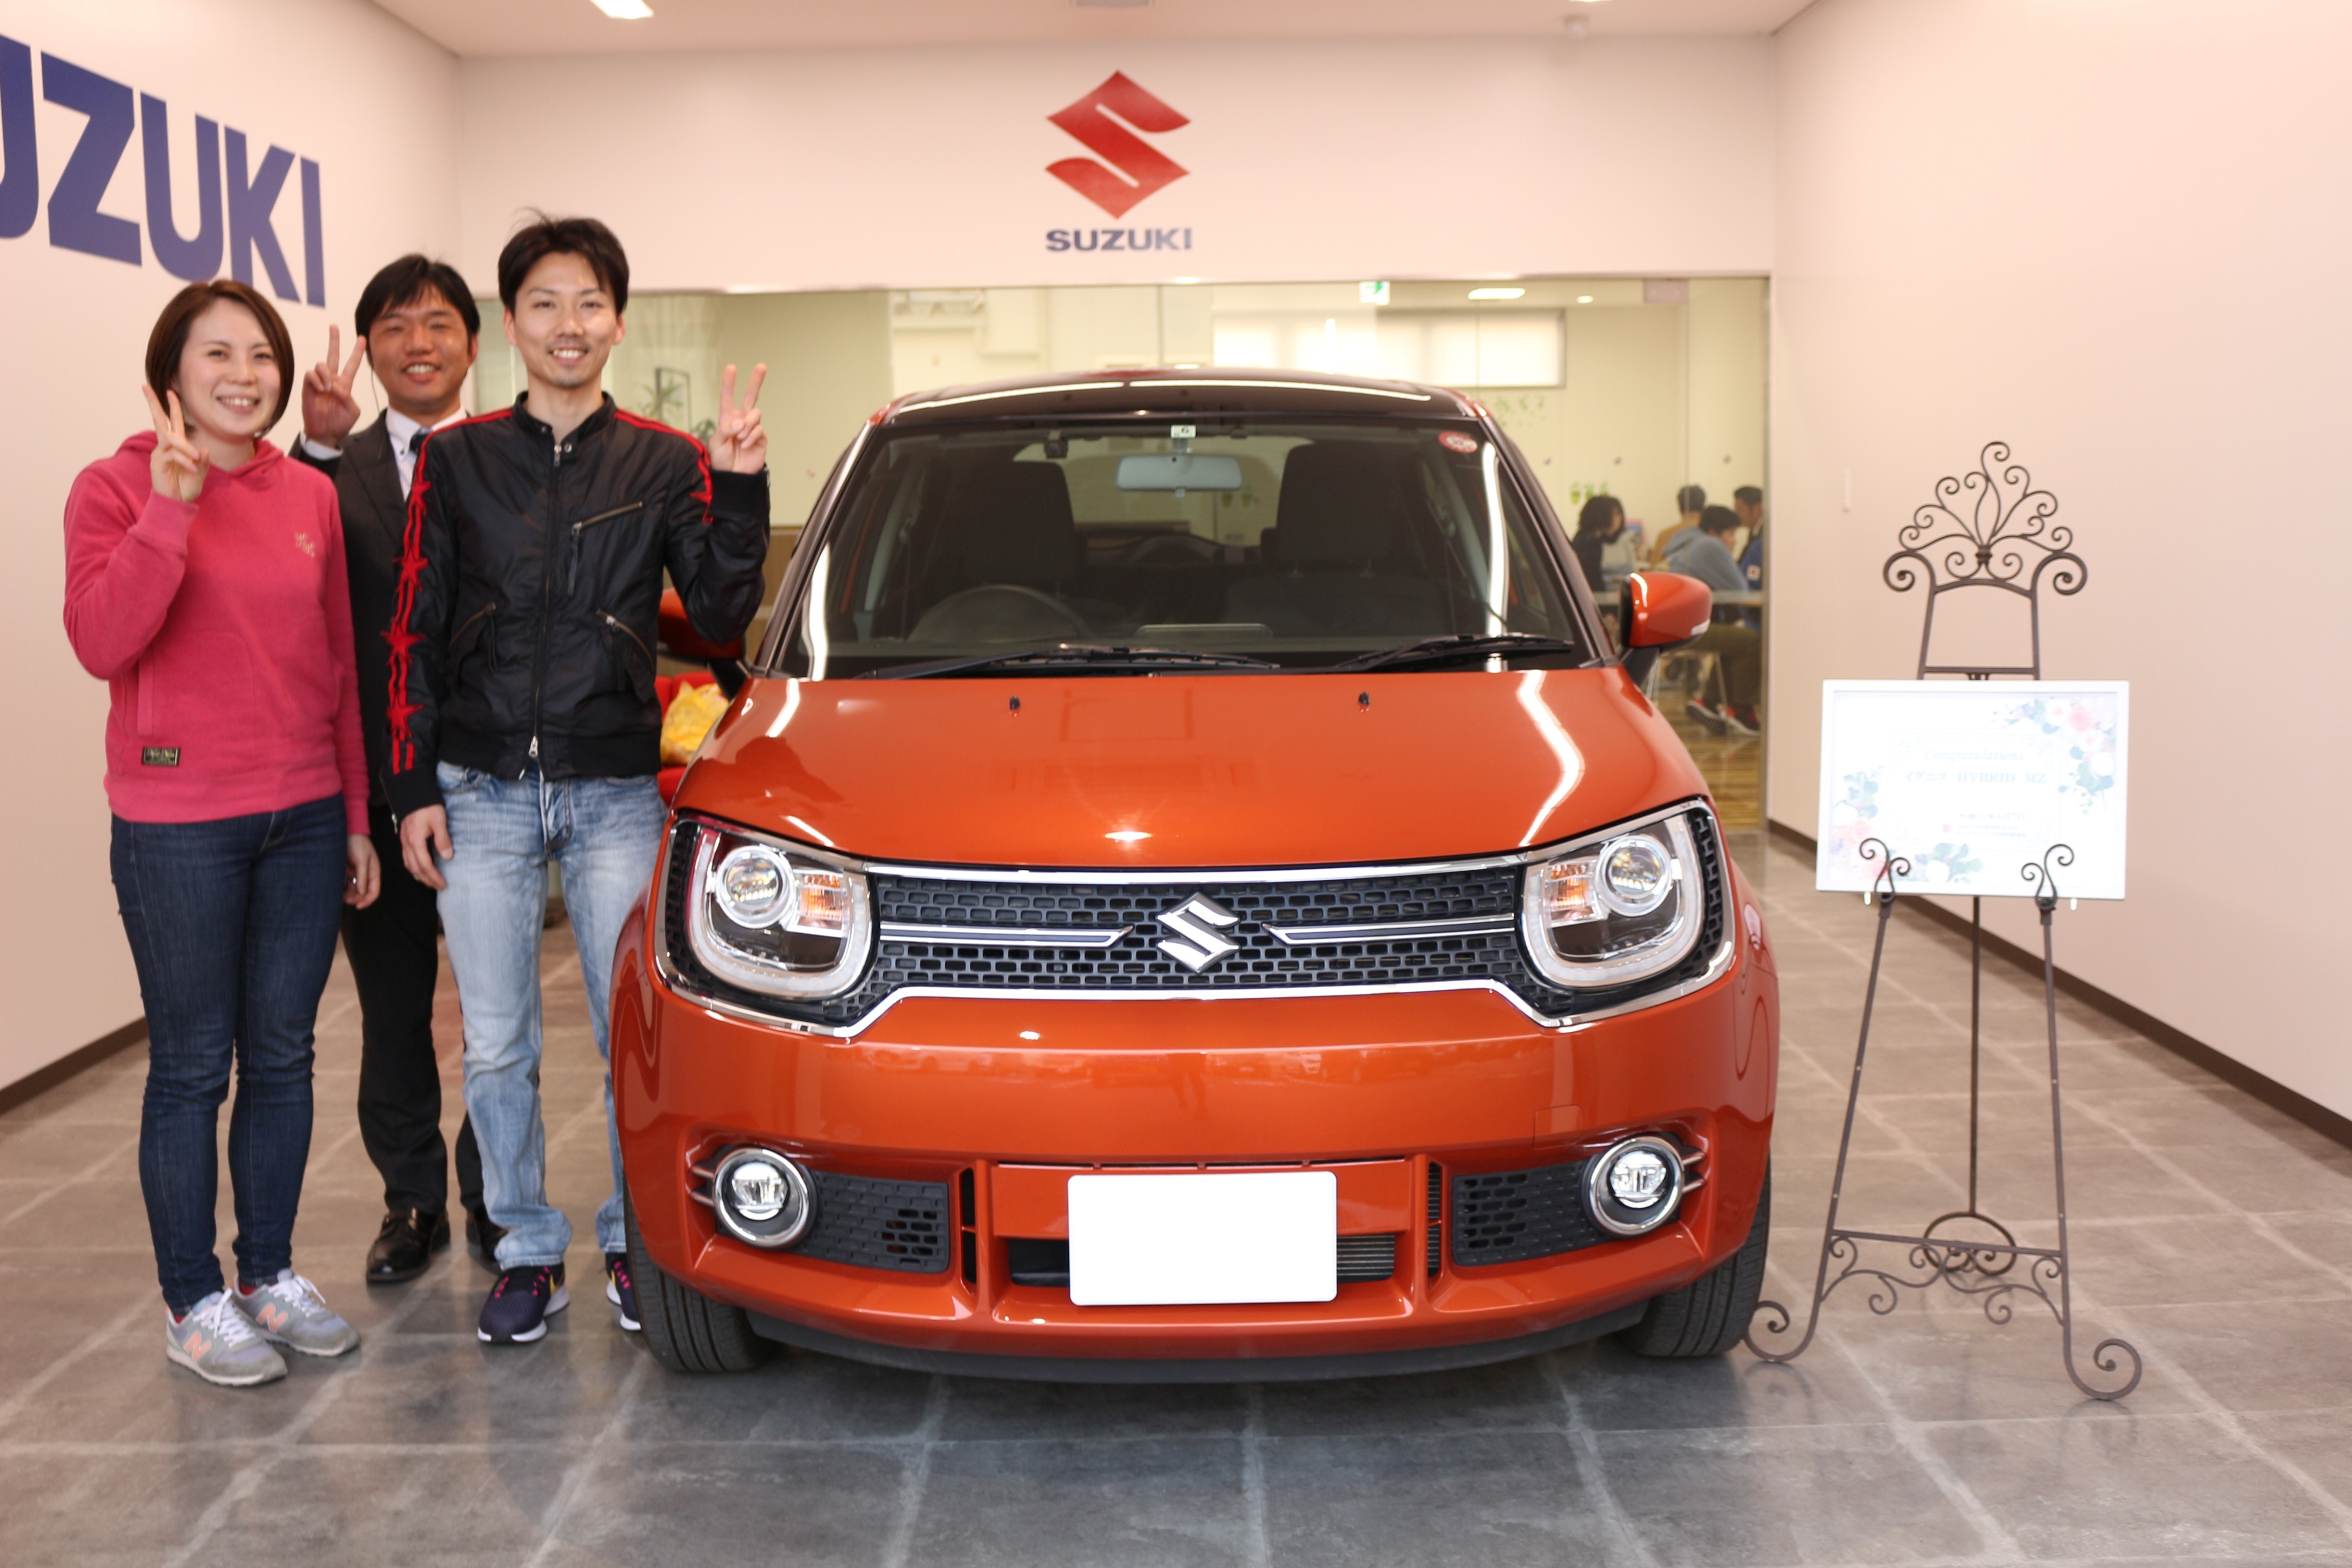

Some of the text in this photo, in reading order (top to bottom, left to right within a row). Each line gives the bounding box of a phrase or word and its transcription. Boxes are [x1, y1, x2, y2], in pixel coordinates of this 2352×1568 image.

[1046, 228, 1192, 251] SUZUKI
[1925, 748, 2025, 764] Congratulations
[1905, 771, 2047, 784] イグニス HYBRID MZ
[255, 1303, 289, 1333] N
[183, 1331, 212, 1361] N
